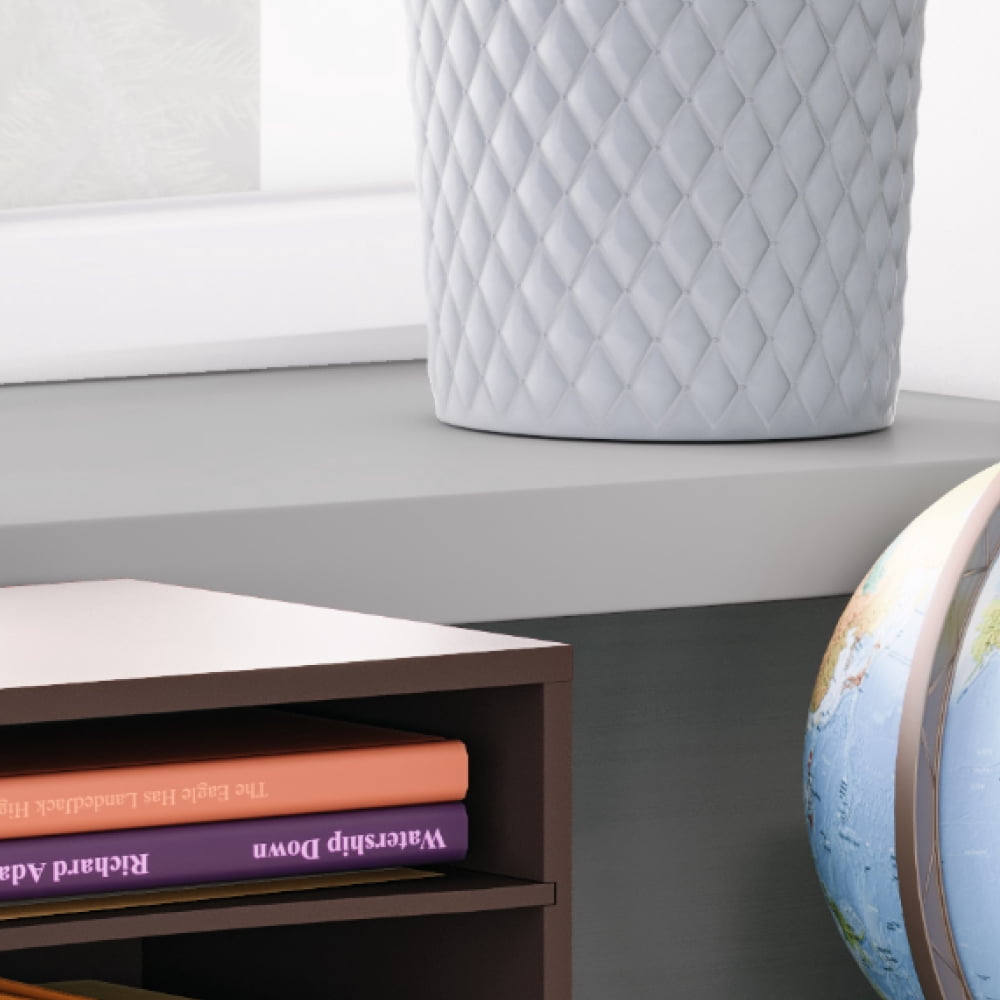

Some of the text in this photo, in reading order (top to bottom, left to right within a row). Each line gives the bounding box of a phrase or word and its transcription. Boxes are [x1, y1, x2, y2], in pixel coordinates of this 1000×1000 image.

[143, 788, 177, 806] Has
[182, 784, 230, 802] Eagle
[235, 782, 268, 800] The
[253, 827, 448, 860] Watership Down
[52, 852, 150, 881] Richard
